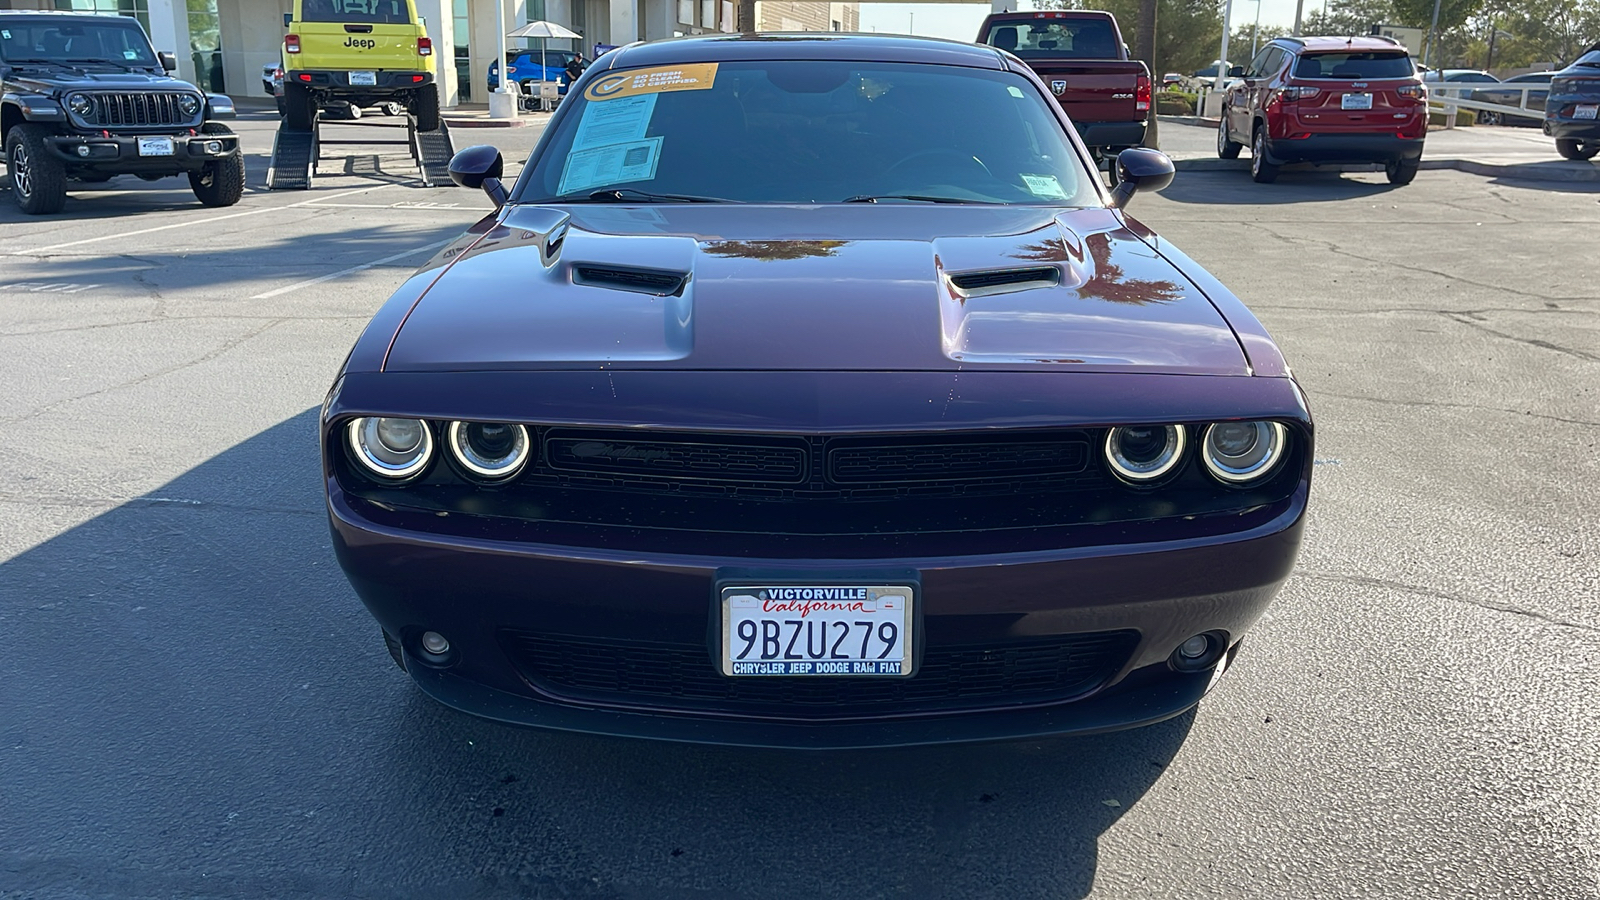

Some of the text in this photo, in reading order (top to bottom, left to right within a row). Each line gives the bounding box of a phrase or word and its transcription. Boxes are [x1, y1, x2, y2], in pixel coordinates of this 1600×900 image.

[344, 36, 375, 50] Jeep
[647, 78, 699, 87] CERTIFIED.
[648, 75, 683, 83] CLEAN.
[768, 588, 867, 600] VICTORVILLE
[763, 600, 877, 618] California
[736, 619, 899, 660] 9BZU279
[733, 662, 901, 675] CHRYSLER JEEP DODGE RAM FIAT
